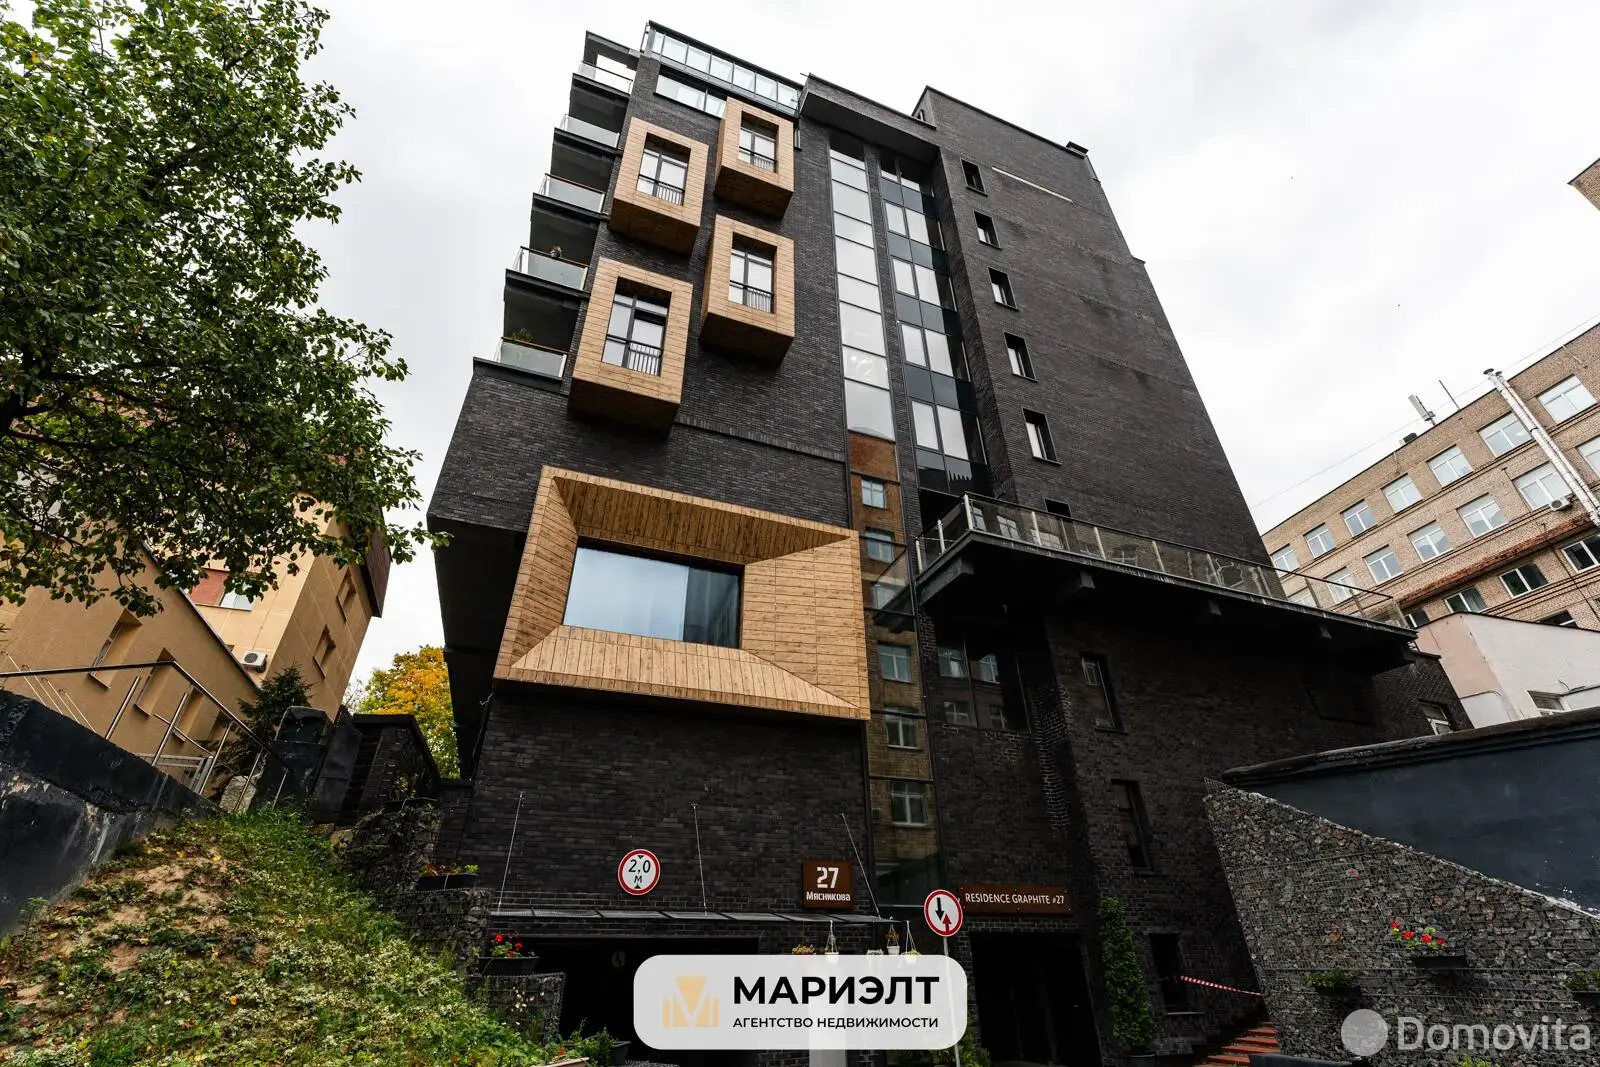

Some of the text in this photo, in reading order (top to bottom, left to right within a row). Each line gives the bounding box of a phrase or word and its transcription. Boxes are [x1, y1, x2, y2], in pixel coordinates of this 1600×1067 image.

[628, 859, 651, 875] 2,0
[816, 866, 839, 889] 27
[806, 891, 851, 901] Мясникова
[965, 893, 1011, 904] RESIDENCE
[1011, 894, 1051, 905] GRAPHITE
